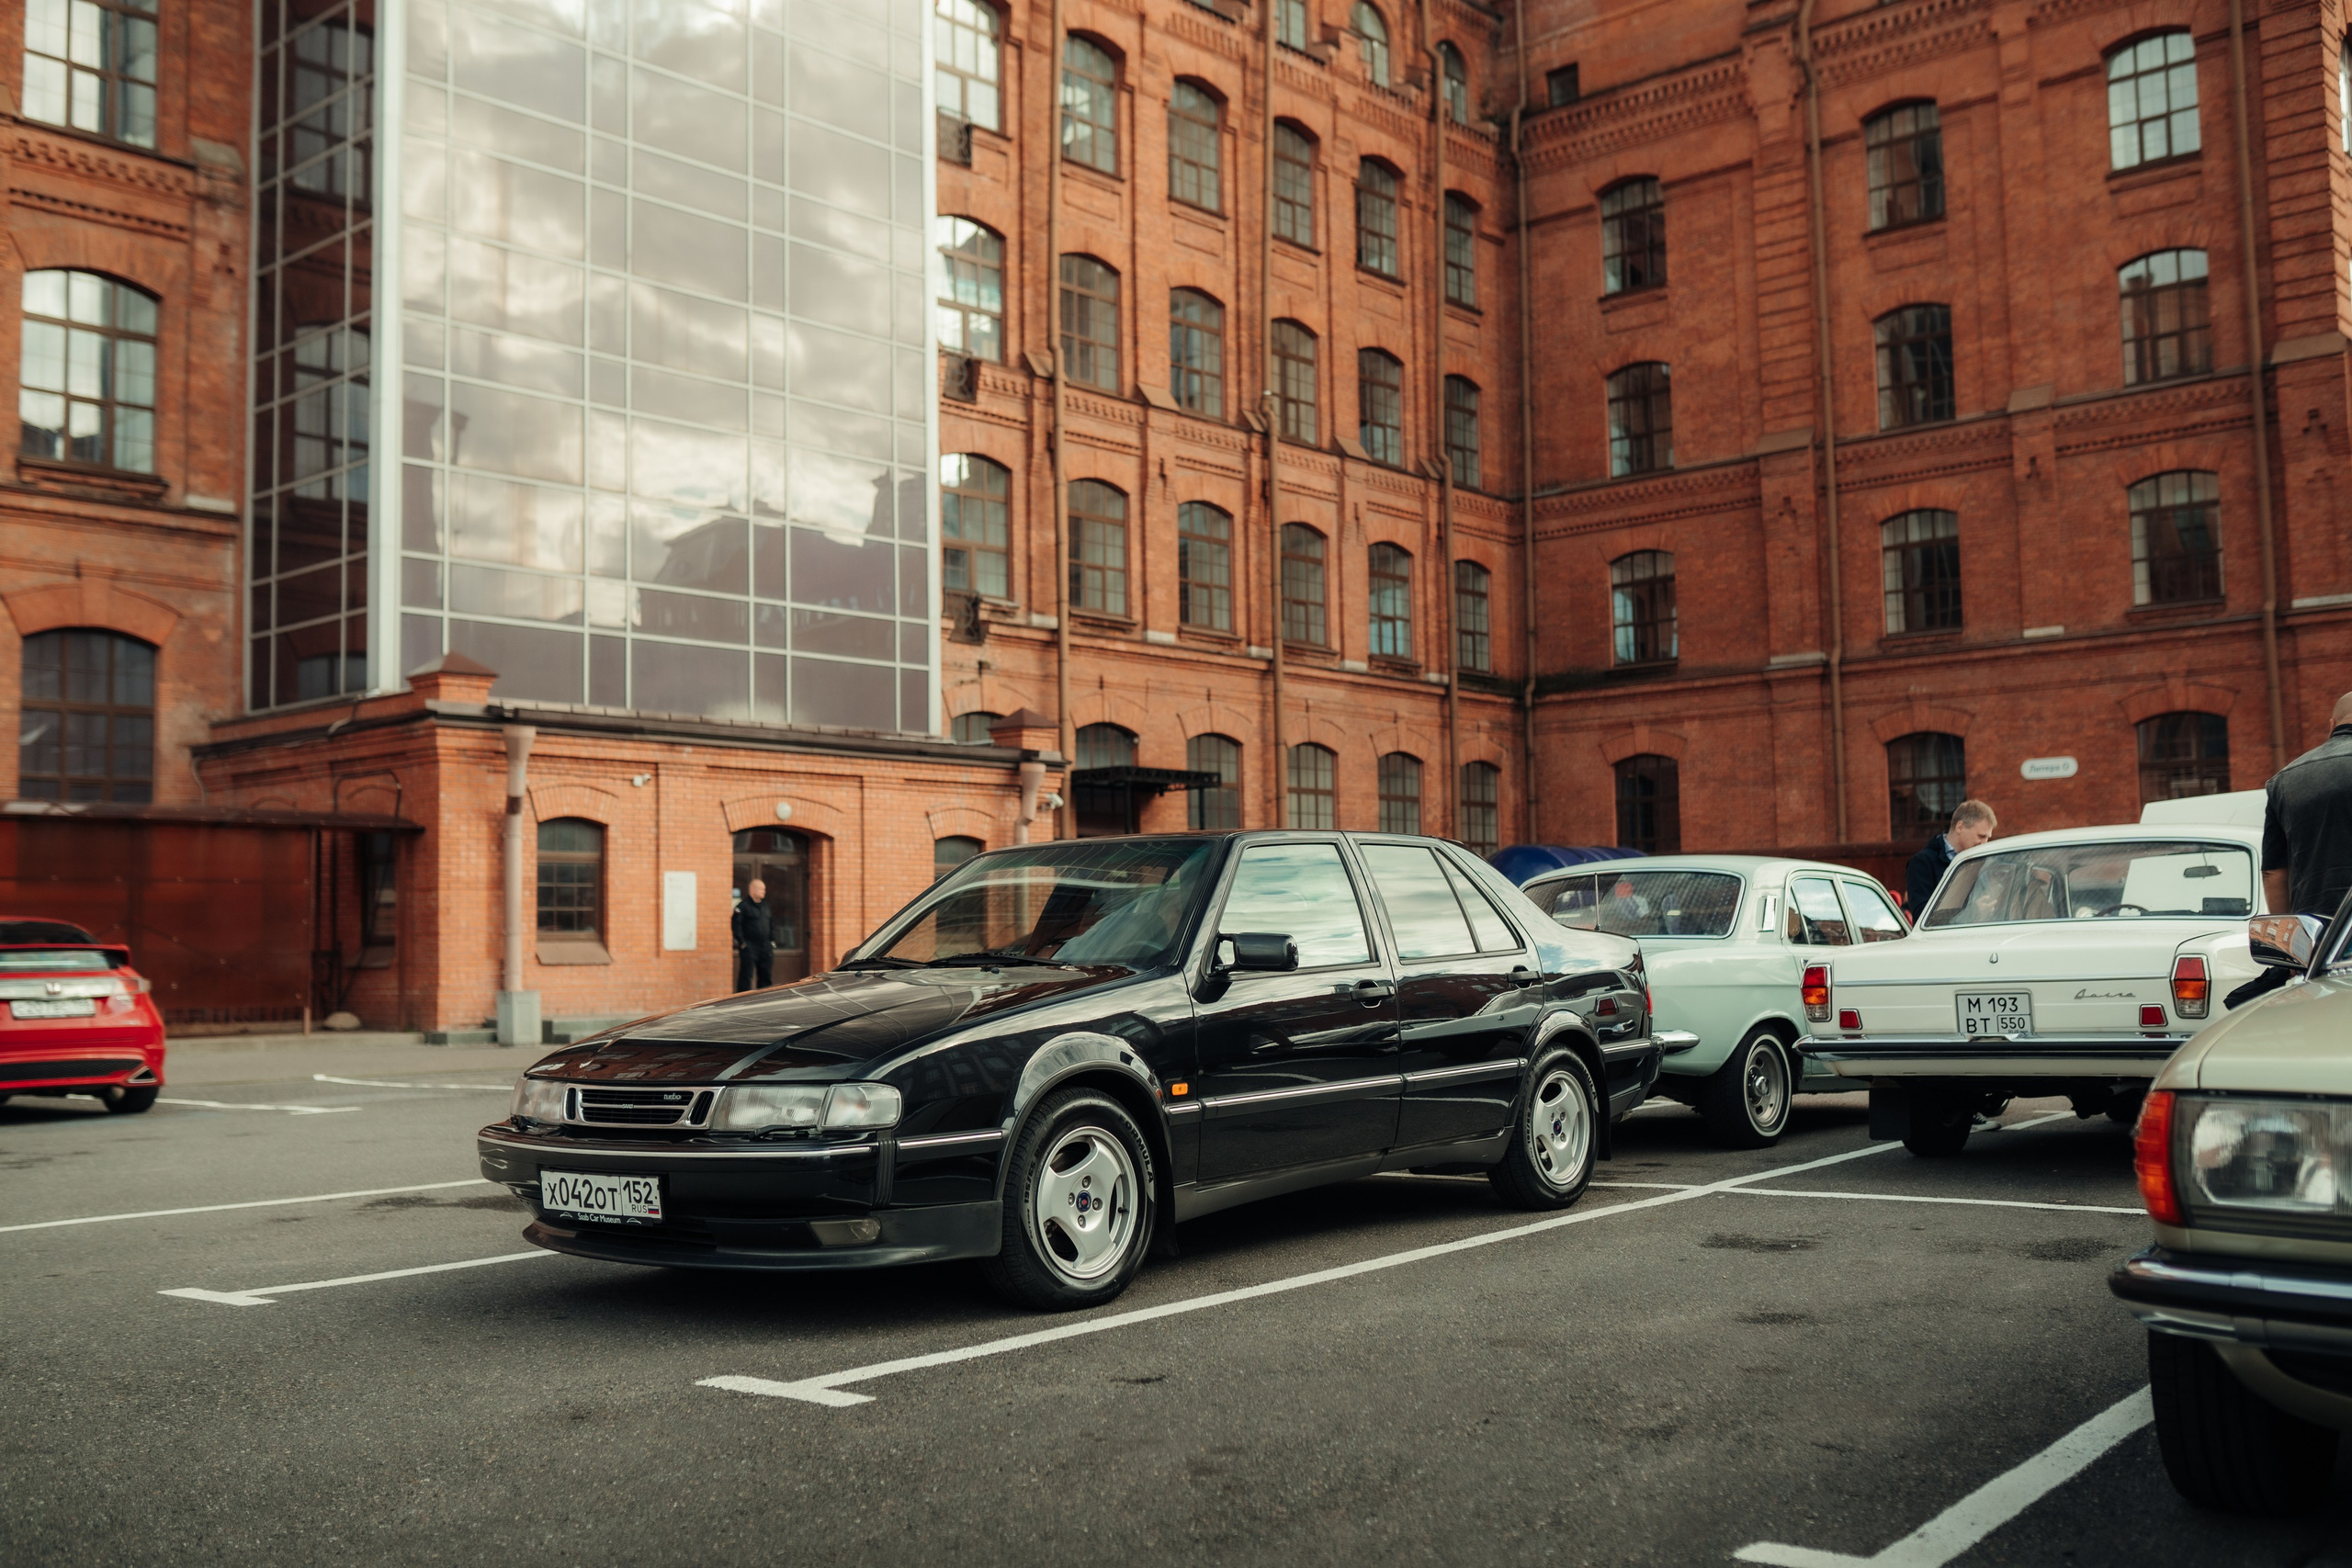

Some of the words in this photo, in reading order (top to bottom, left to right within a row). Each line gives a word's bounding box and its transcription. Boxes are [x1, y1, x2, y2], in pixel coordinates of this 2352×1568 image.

[1967, 998, 1982, 1013] М
[1987, 997, 2018, 1013] 193
[1966, 1018, 1991, 1033] ВТ
[2000, 1017, 2026, 1030] 550
[663, 1092, 682, 1100] turbo
[1118, 1113, 1154, 1183] FORMULA
[622, 1180, 654, 1205] 152
[631, 1204, 648, 1213] RUS
[577, 1212, 589, 1221] Saab
[589, 1213, 599, 1222] Car
[599, 1214, 622, 1224] Museum
